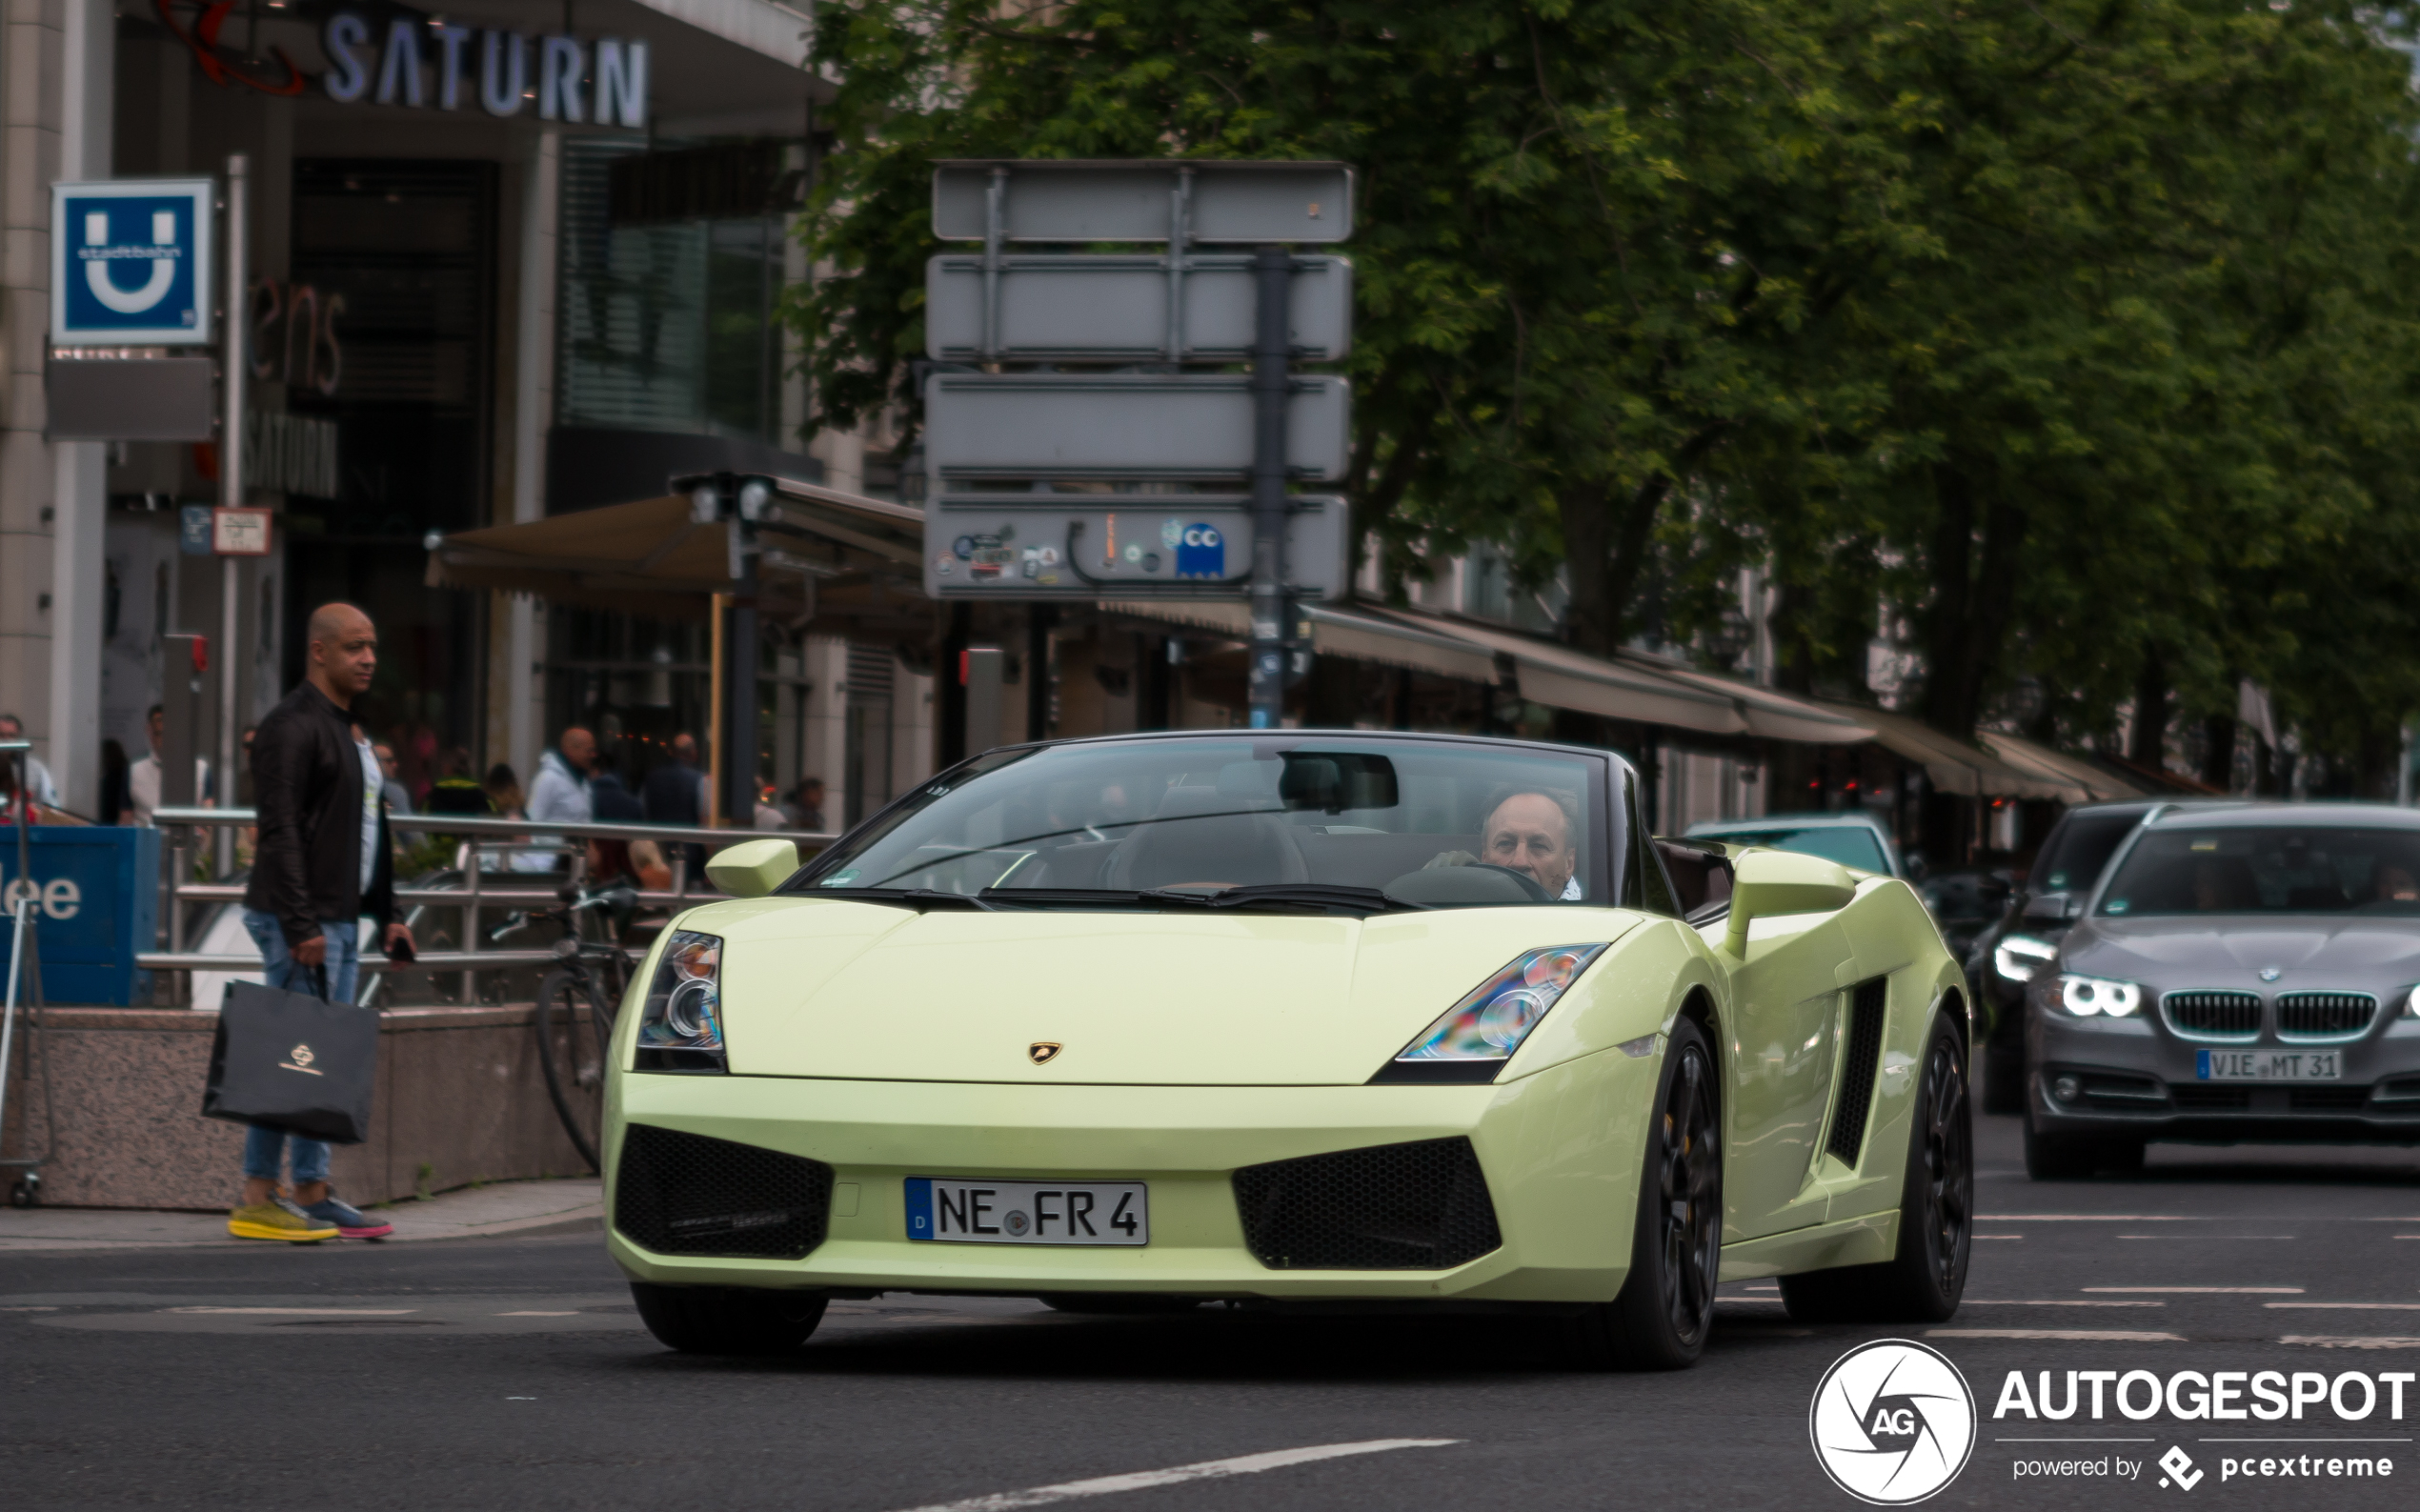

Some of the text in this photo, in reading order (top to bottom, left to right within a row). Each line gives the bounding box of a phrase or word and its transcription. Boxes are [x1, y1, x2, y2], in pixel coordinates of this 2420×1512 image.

[324, 13, 646, 129] SATURN
[77, 246, 182, 259] stadtbahn
[2211, 1054, 2337, 1078] VIE MT 31
[915, 1216, 926, 1229] D
[938, 1187, 1138, 1237] NE FR 4
